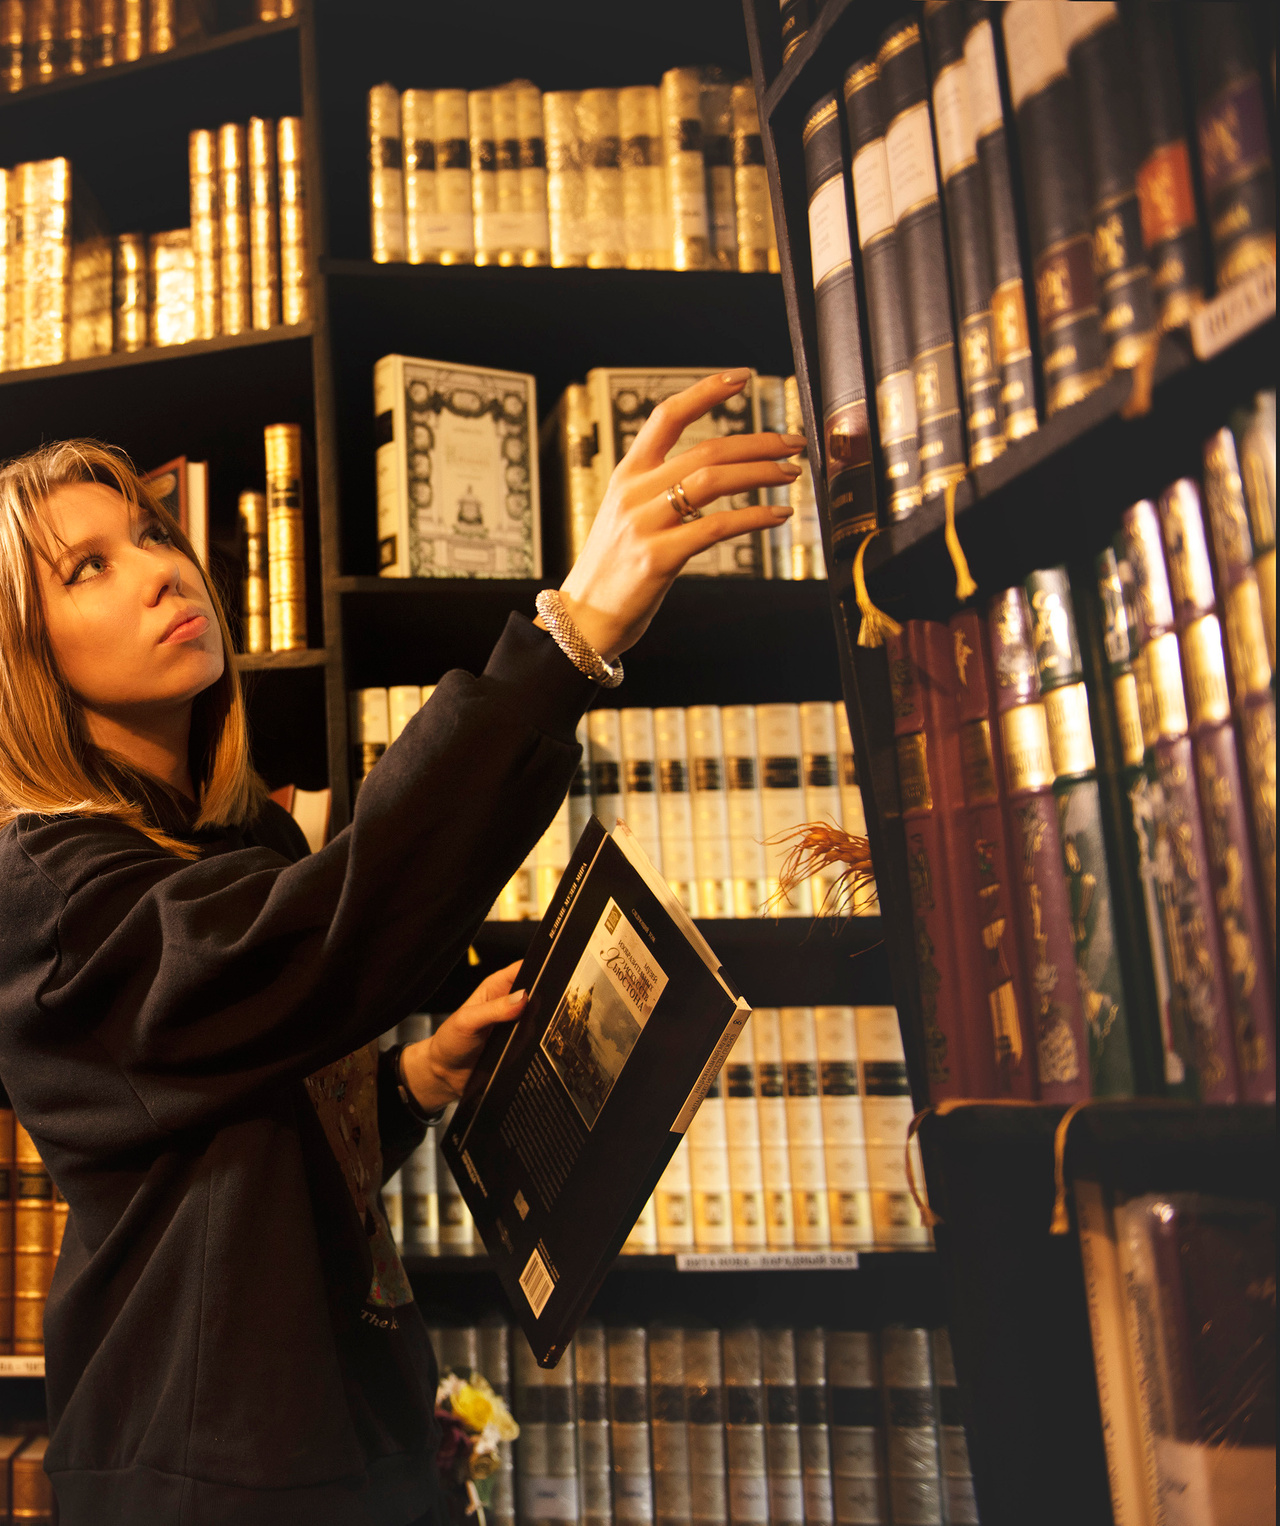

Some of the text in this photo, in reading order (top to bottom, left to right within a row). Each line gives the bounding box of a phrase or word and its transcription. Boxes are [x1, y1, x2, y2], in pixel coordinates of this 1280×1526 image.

[549, 906, 566, 939] ВЕЛИКИЕ
[576, 862, 587, 882] МИРА
[600, 947, 644, 1012] ХЬЮСТОНА
[618, 940, 653, 992] ИЗОБРАЗИТЕЛЬНЫХ
[623, 963, 649, 1002] ИСКУССТВ
[643, 962, 658, 984] МУЗЕЙ
[732, 1018, 743, 1026] 66
[361, 1309, 388, 1328] The
